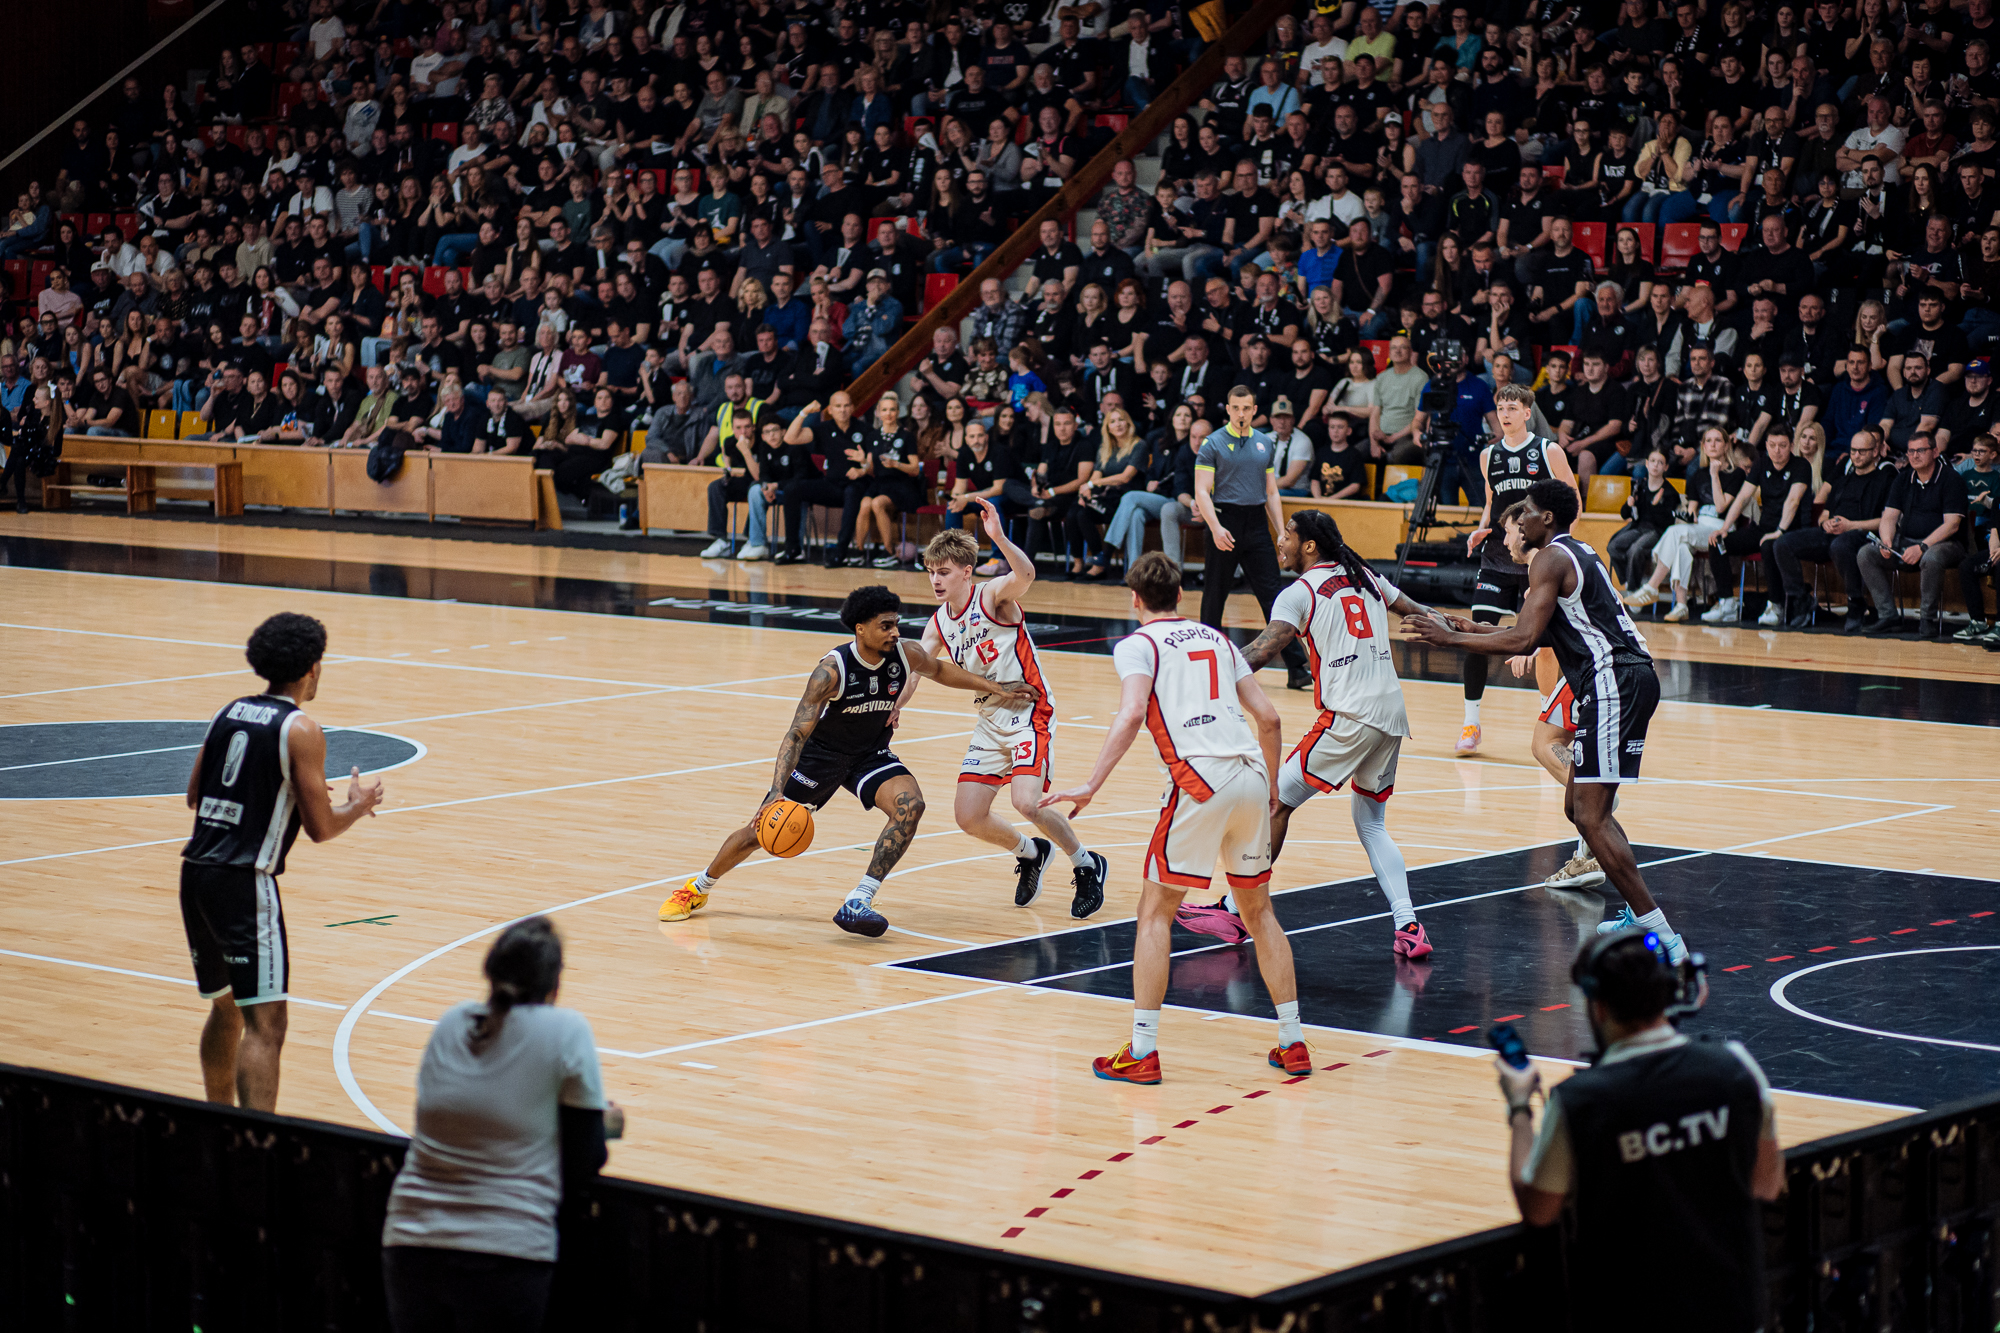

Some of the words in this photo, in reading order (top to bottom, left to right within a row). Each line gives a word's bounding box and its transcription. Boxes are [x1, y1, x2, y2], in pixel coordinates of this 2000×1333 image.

[1604, 164, 1627, 178] VANS
[883, 362, 891, 375] 2
[1508, 456, 1521, 474] 10
[1494, 479, 1537, 496] PRIEVIDZ
[1340, 595, 1374, 640] 8
[1164, 626, 1221, 649] POSPÍŠIL
[975, 639, 999, 665] 13
[1187, 649, 1219, 700] 7
[222, 731, 249, 787] 0
[1014, 741, 1033, 761] 13
[1618, 1104, 1730, 1164] BC.TV
